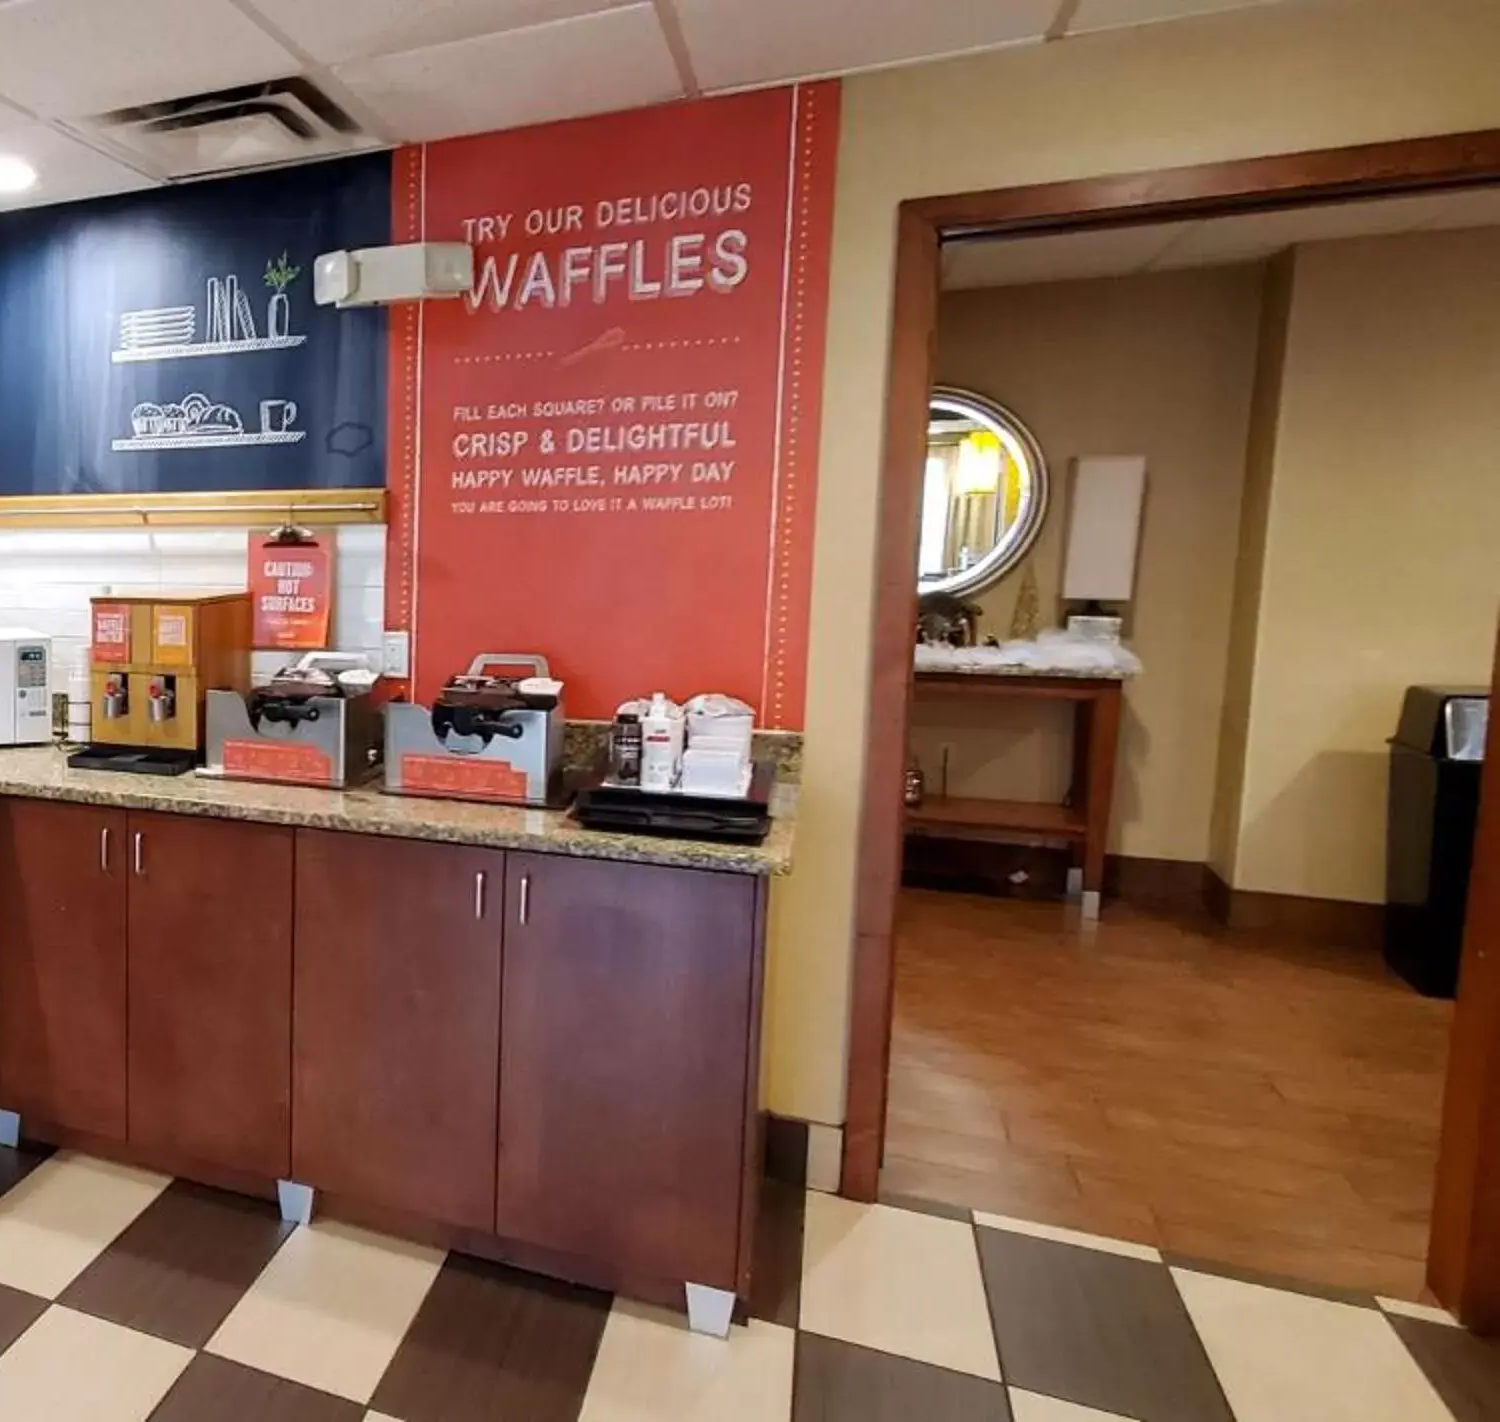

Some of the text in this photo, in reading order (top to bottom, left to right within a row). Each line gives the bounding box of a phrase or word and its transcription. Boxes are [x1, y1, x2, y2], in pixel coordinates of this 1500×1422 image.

[462, 183, 752, 244] TRY OUR DELICIOUS
[465, 229, 749, 314] WAFFLES
[453, 405, 482, 421] FILL
[486, 403, 528, 420] EACH
[533, 398, 605, 417] SQUARE?
[611, 396, 636, 413] OR
[641, 394, 677, 411] PILE
[681, 393, 699, 410] IT
[452, 420, 737, 458] CRISP & DELIGHTFUL
[451, 461, 736, 489] HAPPY WAFFLE, HAPPY DAY
[451, 502, 476, 514] YOU
[479, 501, 505, 514] ARE
[507, 499, 548, 513] GOING
[552, 499, 570, 512] TO
[573, 498, 607, 512] LOVE
[626, 498, 638, 511] A
[642, 496, 696, 512] WAFFLE
[277, 579, 300, 595] HOT
[260, 595, 315, 612] SURFACES
